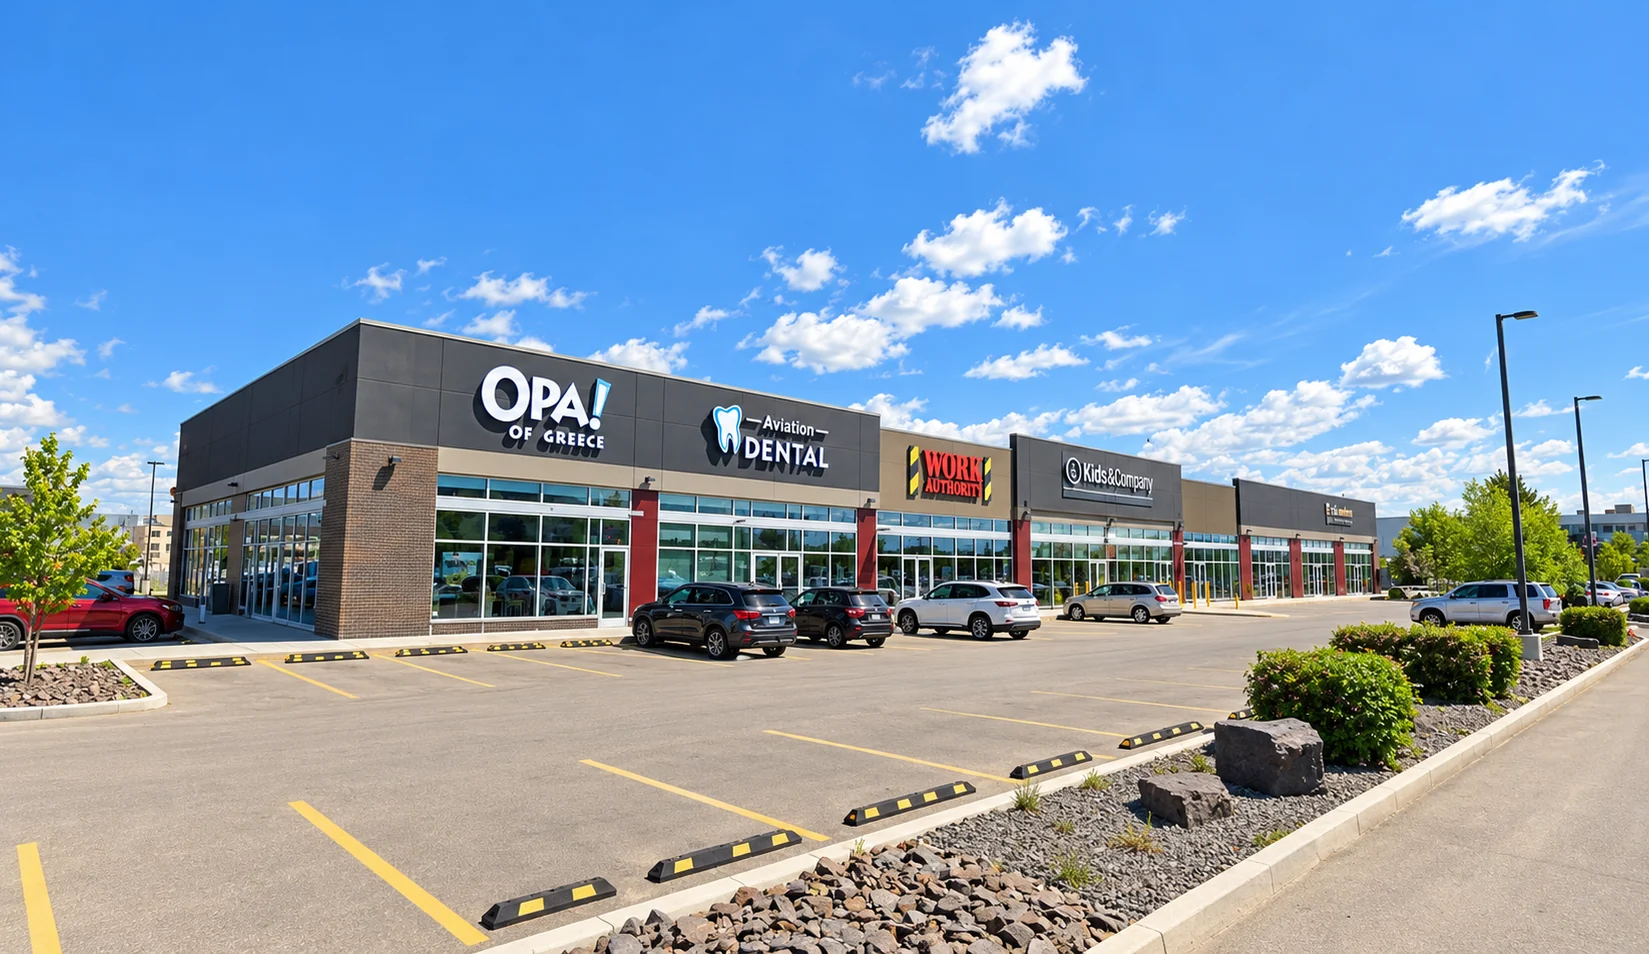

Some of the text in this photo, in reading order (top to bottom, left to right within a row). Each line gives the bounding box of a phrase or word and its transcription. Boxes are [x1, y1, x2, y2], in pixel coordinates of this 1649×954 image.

[481, 365, 612, 430] OPA!
[508, 424, 605, 449] OF GREECE
[762, 414, 815, 437] Aviation
[744, 435, 829, 469] DENTAL
[924, 449, 983, 482] WORK
[925, 477, 982, 498] AUTHORITY
[1083, 462, 1154, 495] Kids&Company
